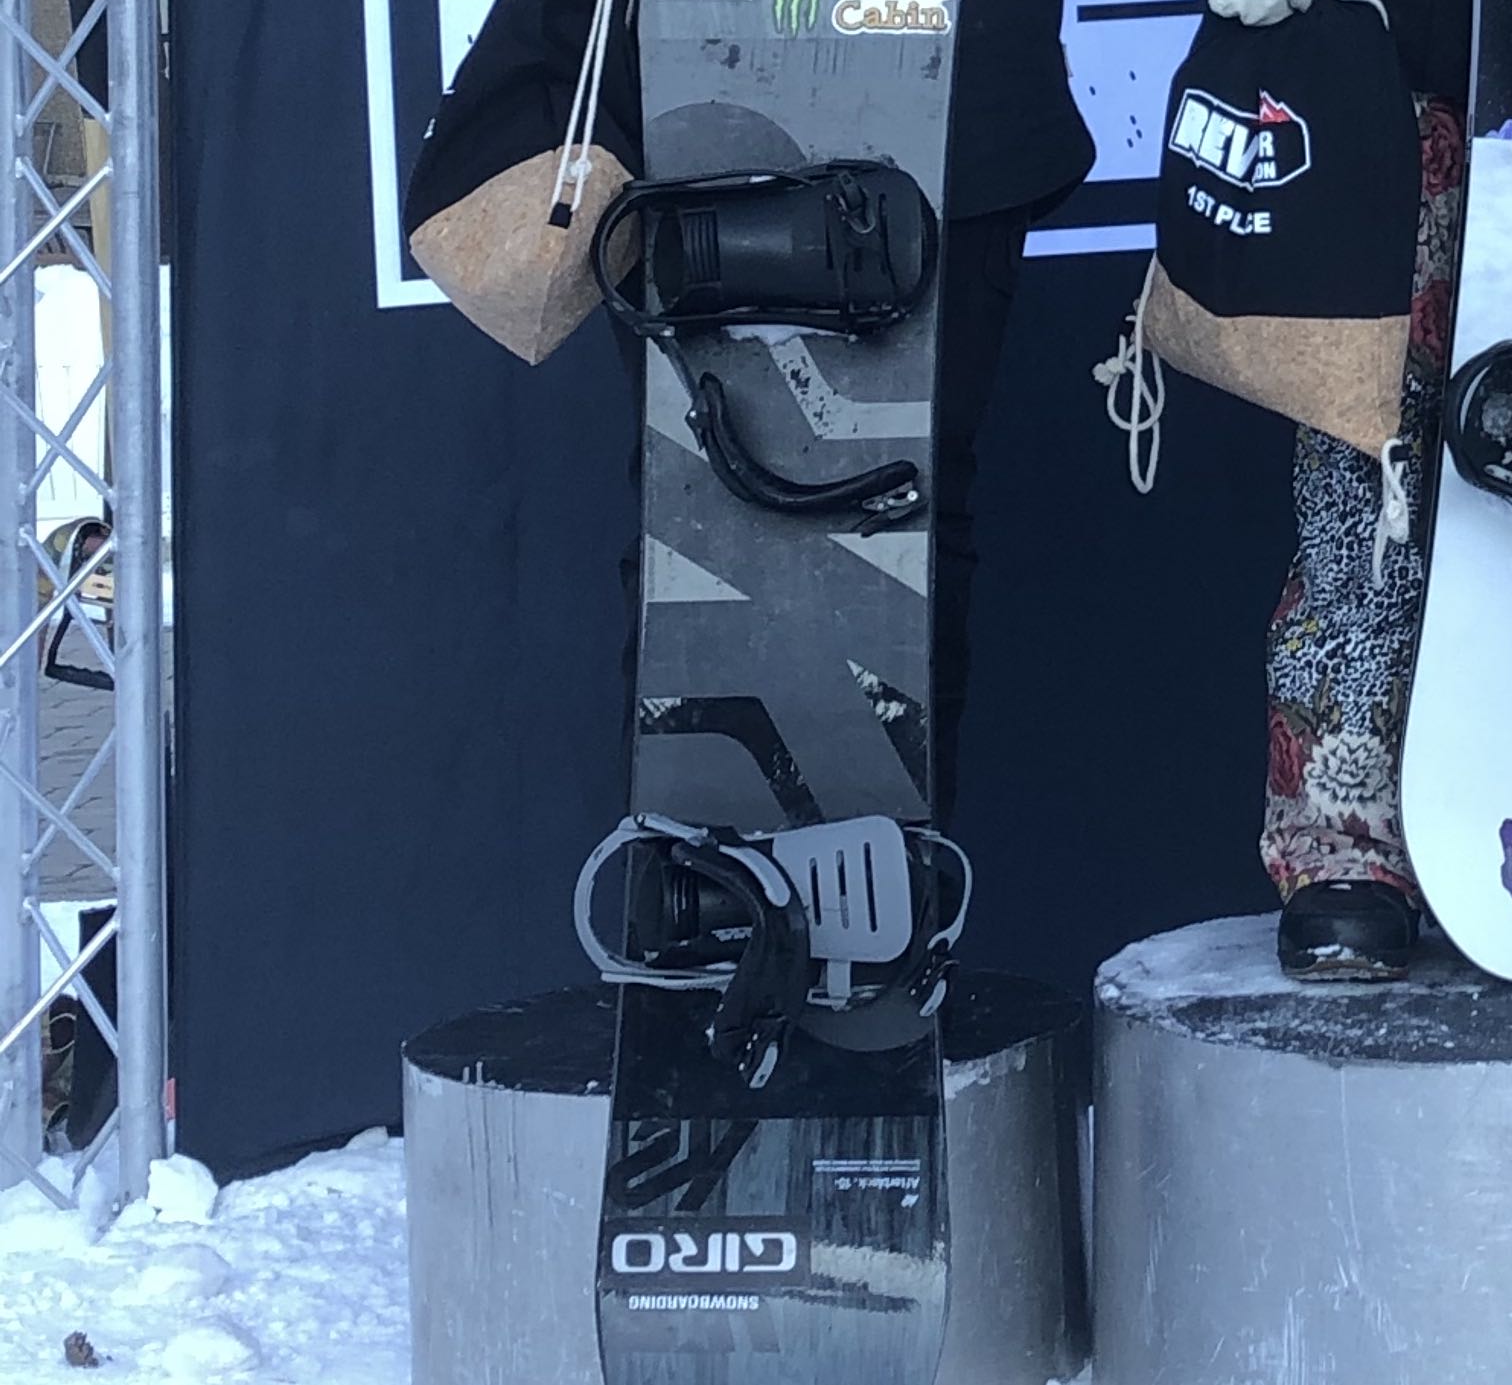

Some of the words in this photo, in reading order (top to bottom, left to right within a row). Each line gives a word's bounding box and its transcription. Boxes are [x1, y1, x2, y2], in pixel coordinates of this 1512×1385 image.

[834, 0, 948, 30] Cabin
[1174, 98, 1259, 179] REV
[1187, 185, 1216, 217] 1ST
[611, 1232, 797, 1274] GIRO
[628, 1294, 760, 1311] SNOWBOARDING
